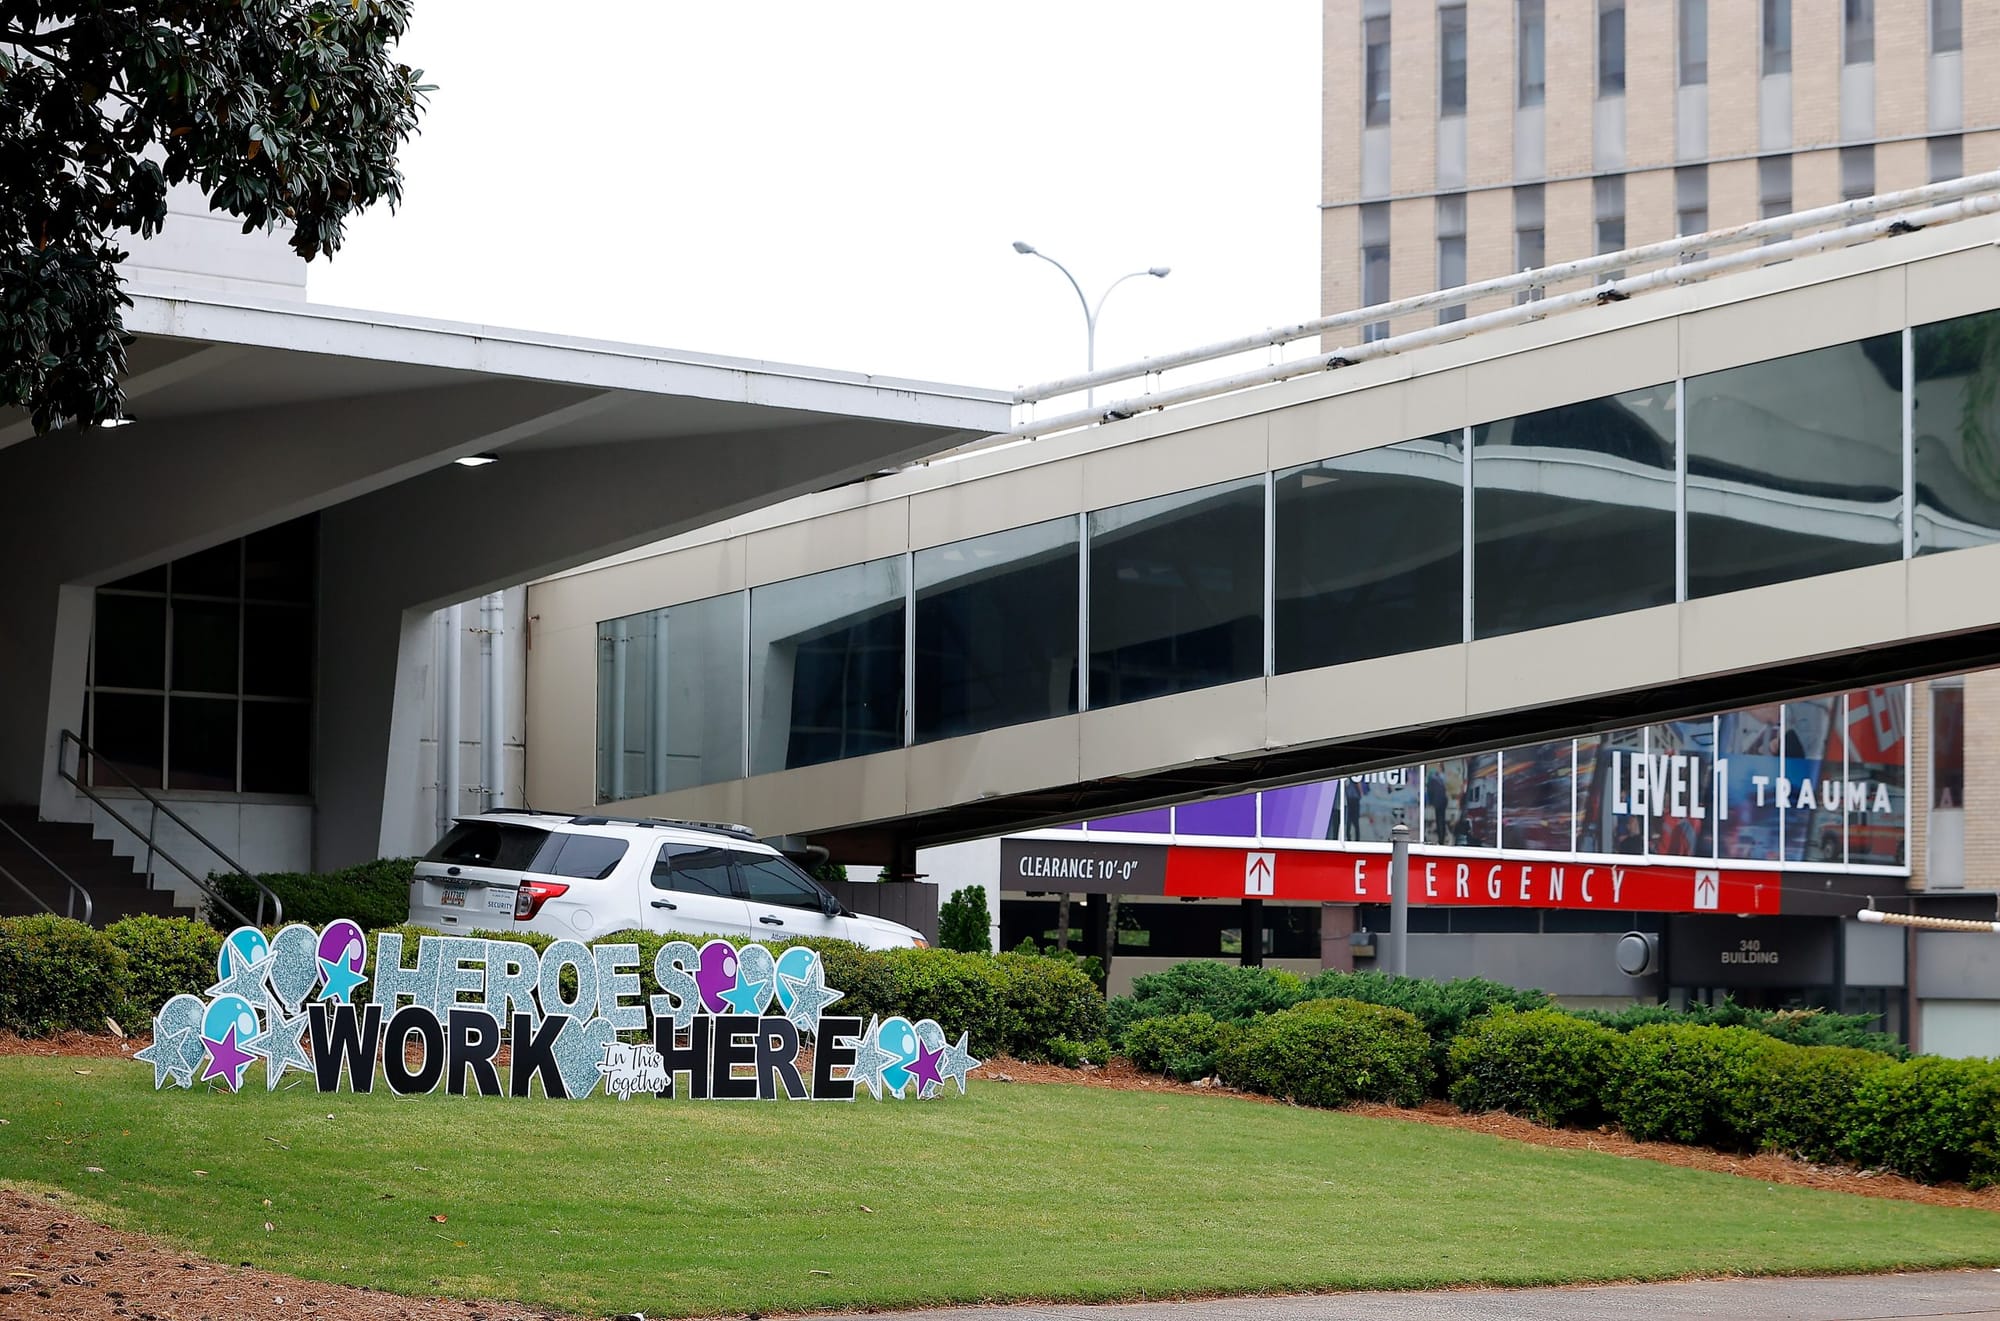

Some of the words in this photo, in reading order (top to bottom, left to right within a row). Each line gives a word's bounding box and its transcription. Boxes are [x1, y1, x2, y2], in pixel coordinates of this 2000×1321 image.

[1612, 751, 1706, 819] LEVEL
[1716, 758, 1728, 820] 1
[1752, 775, 1892, 813] TRAUMA
[1019, 856, 1094, 879] CLEARANCE
[1354, 860, 1625, 903] EERGENCY
[487, 900, 513, 910] SECURITY
[1721, 951, 1779, 963] BUILDING
[1739, 939, 1761, 951] 340
[372, 932, 703, 1030] HEROES
[306, 1003, 572, 1101] WORK
[596, 1042, 625, 1067] In
[628, 1046, 661, 1071] This
[653, 1013, 863, 1101] HERE
[602, 1068, 669, 1101] Together
